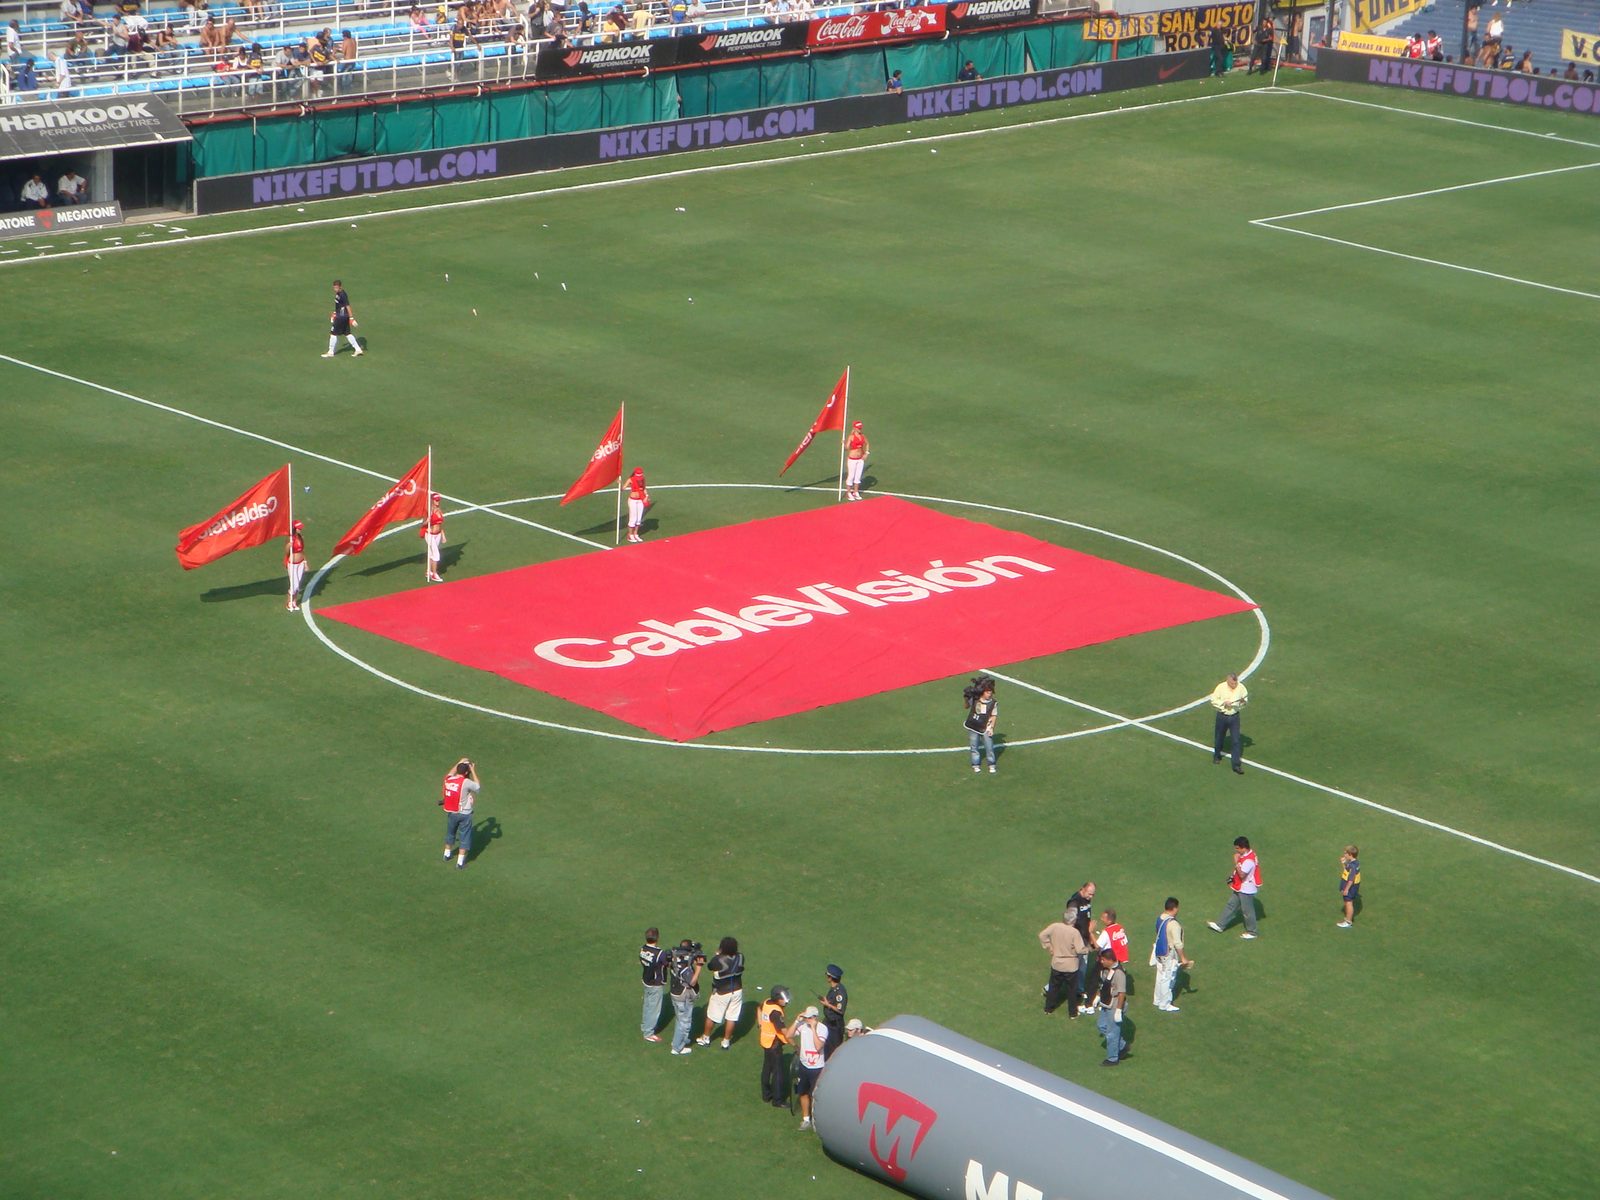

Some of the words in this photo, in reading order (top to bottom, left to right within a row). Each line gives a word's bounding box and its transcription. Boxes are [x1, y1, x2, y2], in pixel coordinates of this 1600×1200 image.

[1162, 11, 1195, 33] SAN
[1199, 4, 1254, 30] JUSTO
[907, 67, 1102, 118] NIKEFUTBOL.COM
[40, 121, 126, 137] PERFORMANCE
[130, 118, 160, 127] TIRES
[599, 107, 815, 159] NIKEFUTBOL.COM
[253, 148, 497, 204] NIKEFUTBOL.COM
[56, 206, 117, 223] MEGATONE
[534, 554, 1055, 668] CableVisión
